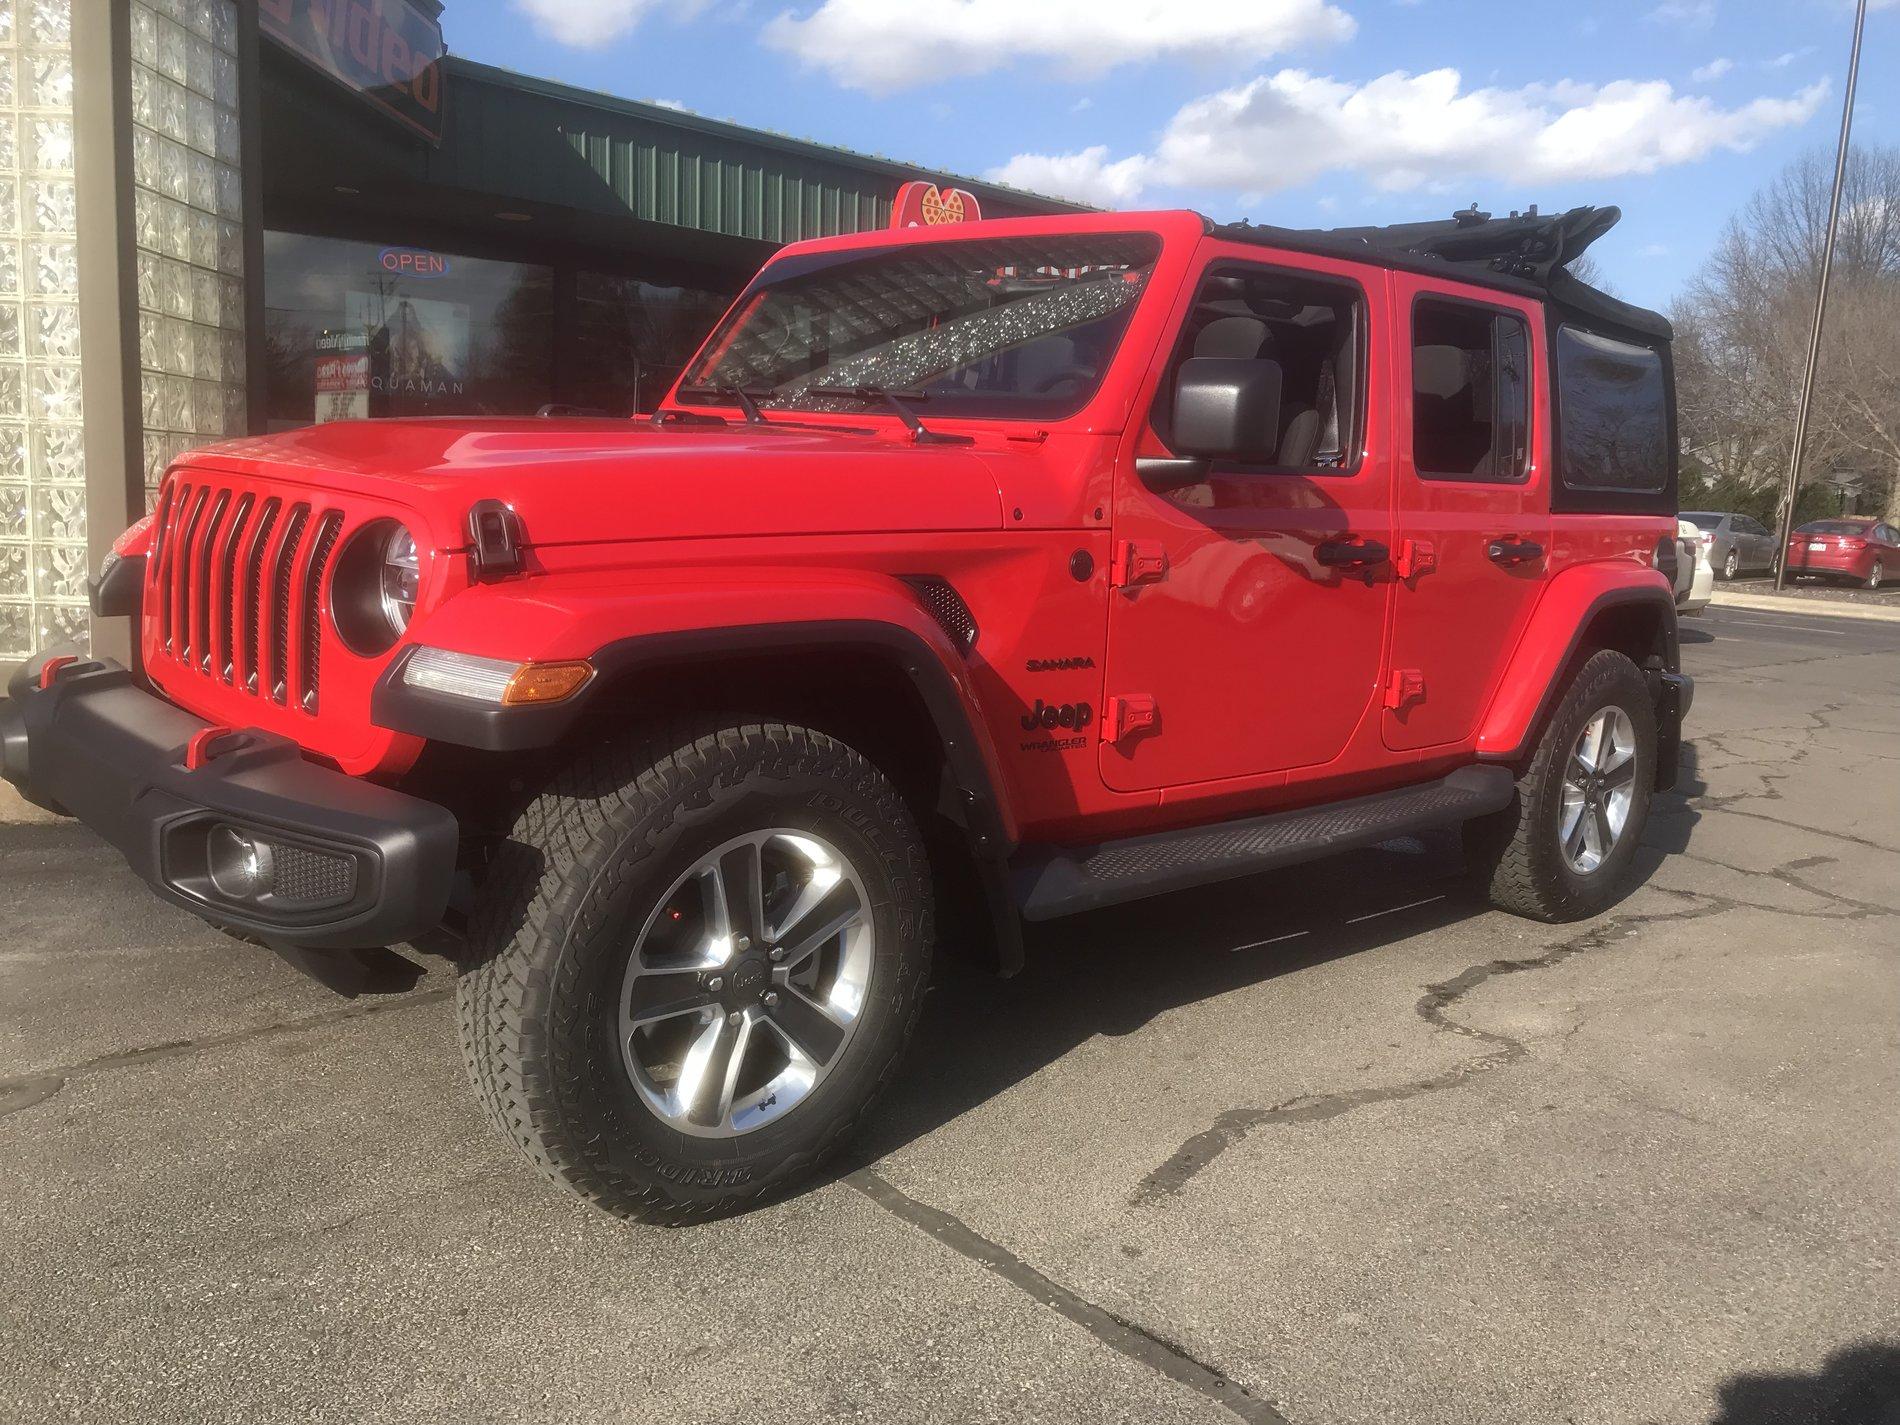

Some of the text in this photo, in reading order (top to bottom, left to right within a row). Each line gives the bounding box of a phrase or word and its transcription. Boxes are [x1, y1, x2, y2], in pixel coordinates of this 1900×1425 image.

[383, 253, 443, 272] OPEN
[1026, 657, 1096, 672] SAHARA
[1021, 699, 1093, 733] Jeep
[1020, 737, 1087, 752] WRANGLER
